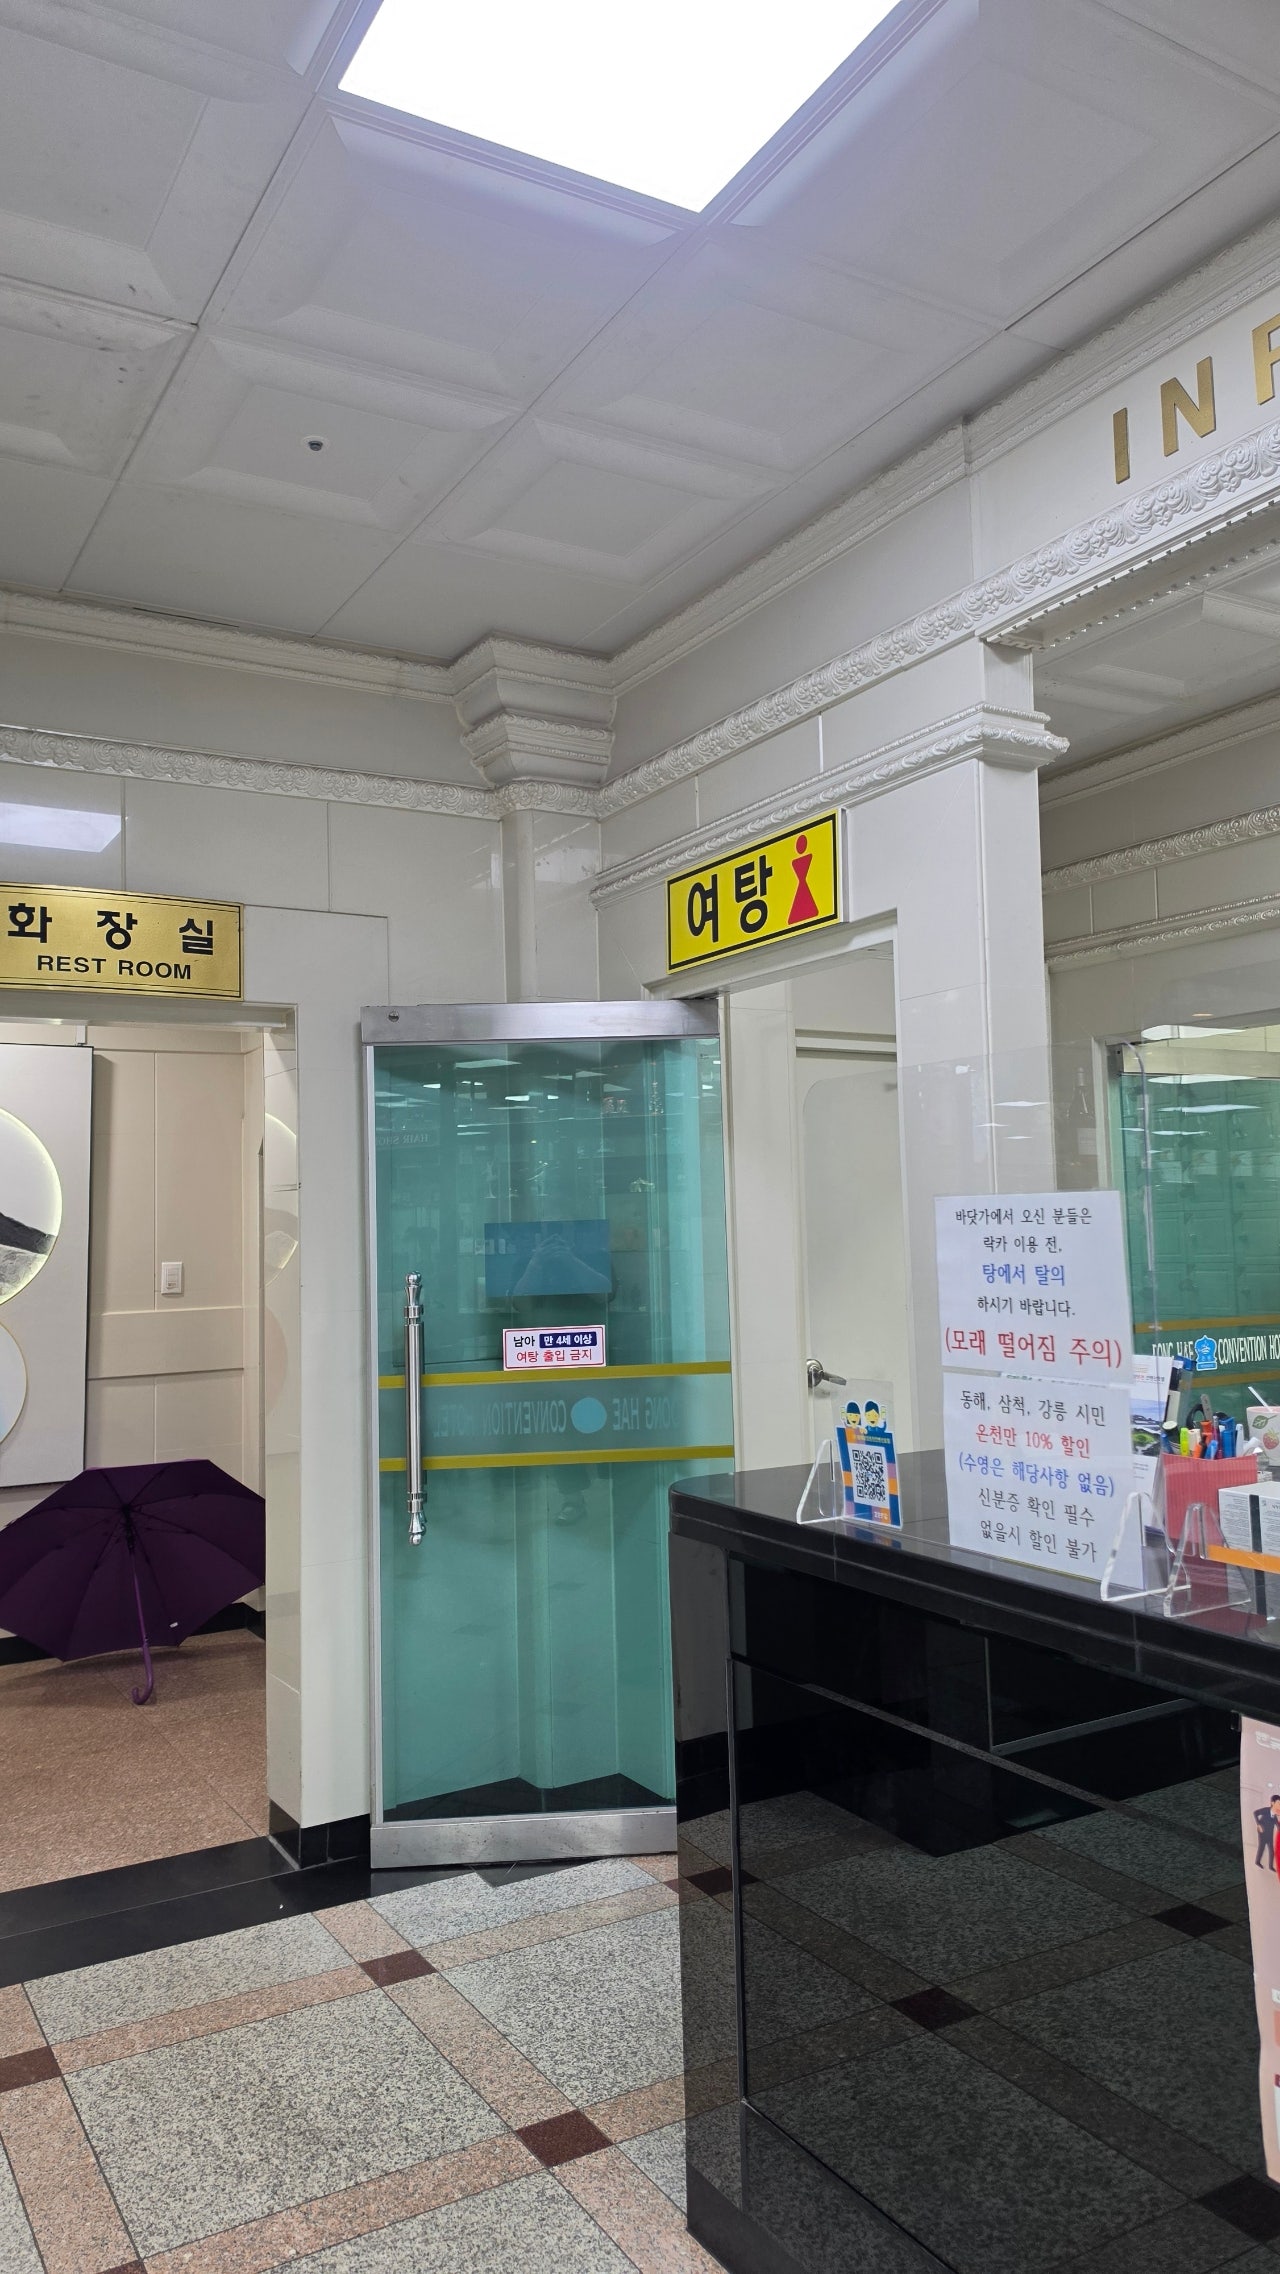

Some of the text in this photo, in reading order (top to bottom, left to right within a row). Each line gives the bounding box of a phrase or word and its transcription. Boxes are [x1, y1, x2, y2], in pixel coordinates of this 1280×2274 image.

[688, 854, 773, 943] 여탕
[37, 954, 191, 980] REST ROOM
[955, 1207, 1092, 1226] 바닷가에서 오신 분들은
[983, 1235, 1008, 1253] 락카
[1013, 1236, 1039, 1254] 이용
[982, 1263, 1066, 1286] 탕에서 탈의
[976, 1295, 1076, 1318] 하시기 바랍니다.
[513, 1333, 593, 1348] 남아 만 4세 이상
[945, 1327, 1123, 1369] (모래 떨어짐 주의)
[1218, 1333, 1280, 1365] CONVENTION HO
[516, 1348, 593, 1363] 여탕 출입 금지
[1038, 1399, 1067, 1422] 강릉
[1075, 1404, 1106, 1427] 시민
[976, 1424, 1090, 1459] 온천만 10% 할인
[959, 1452, 1115, 1498] (수영은 해당사항 없음)
[978, 1488, 1095, 1528] 신분증 확인 필수
[980, 1520, 1096, 1563] 없을시 할인 불가
